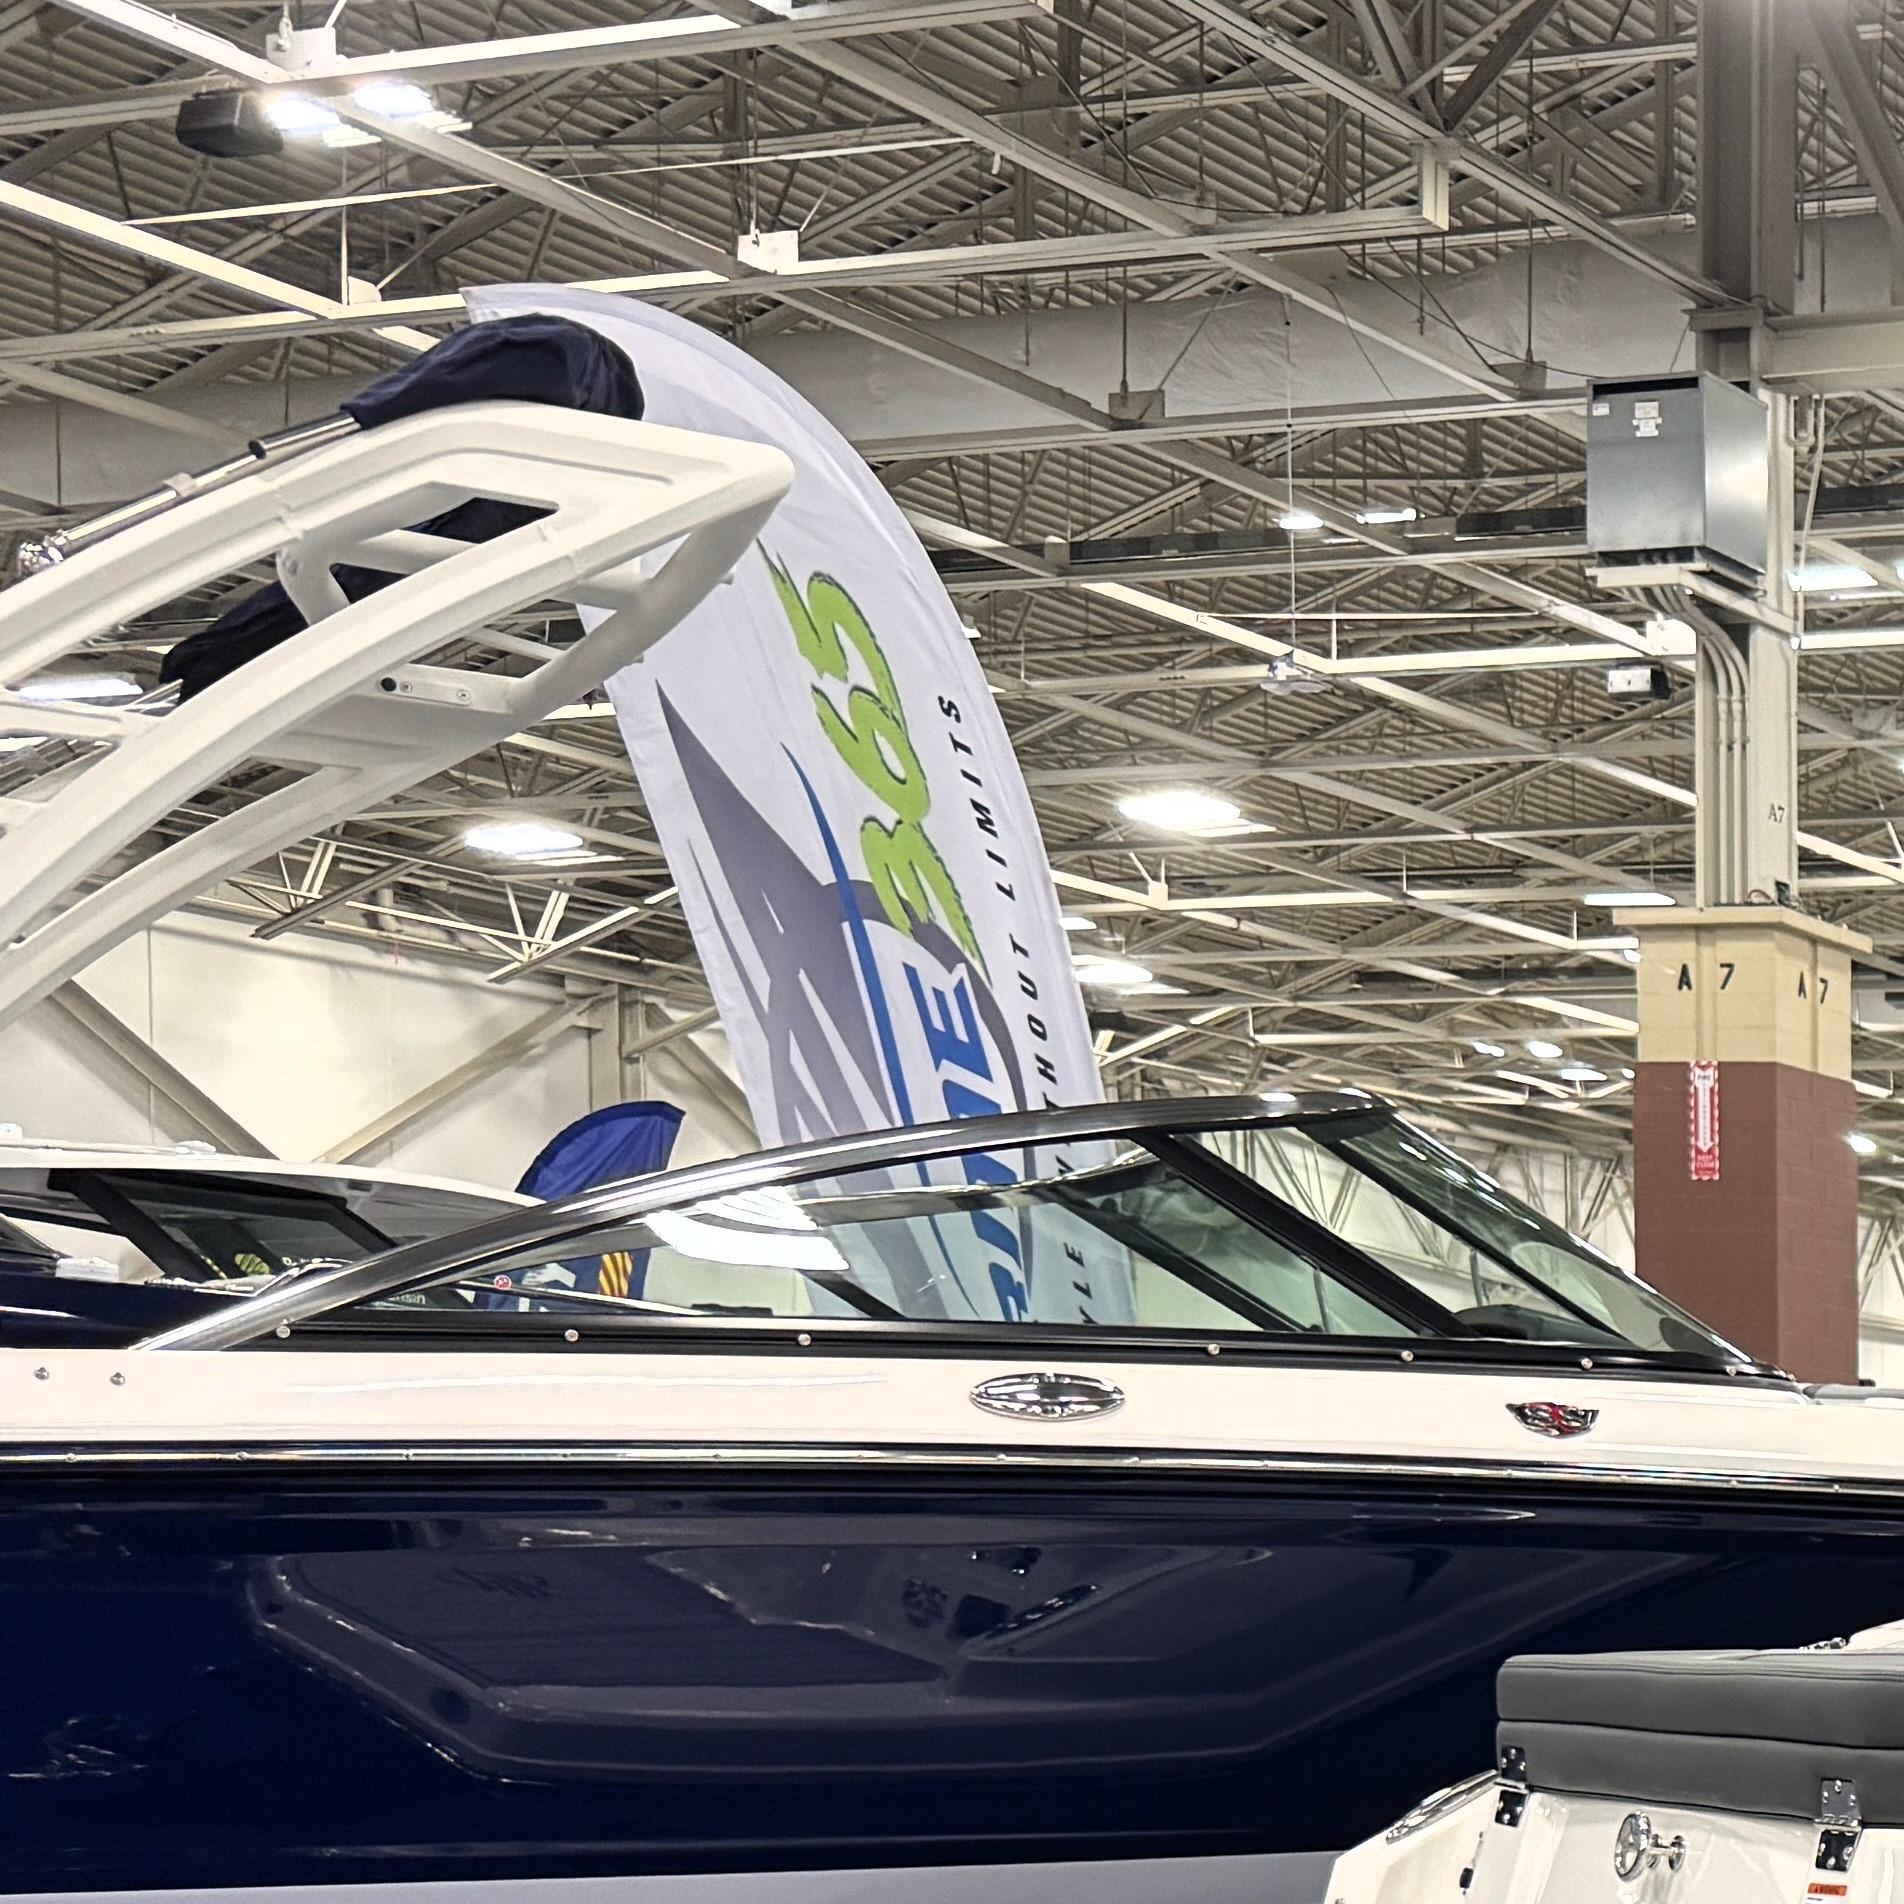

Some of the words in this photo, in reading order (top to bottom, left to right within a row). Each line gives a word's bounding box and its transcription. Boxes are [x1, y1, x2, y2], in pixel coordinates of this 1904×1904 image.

[757, 539, 992, 988] 365
[937, 692, 1017, 905] LIMITS
[1008, 933, 1077, 1183] THOUT
[1677, 963, 1693, 991] A
[1719, 963, 1735, 990] 7
[1797, 972, 1807, 999] A
[1820, 978, 1829, 1004] 7
